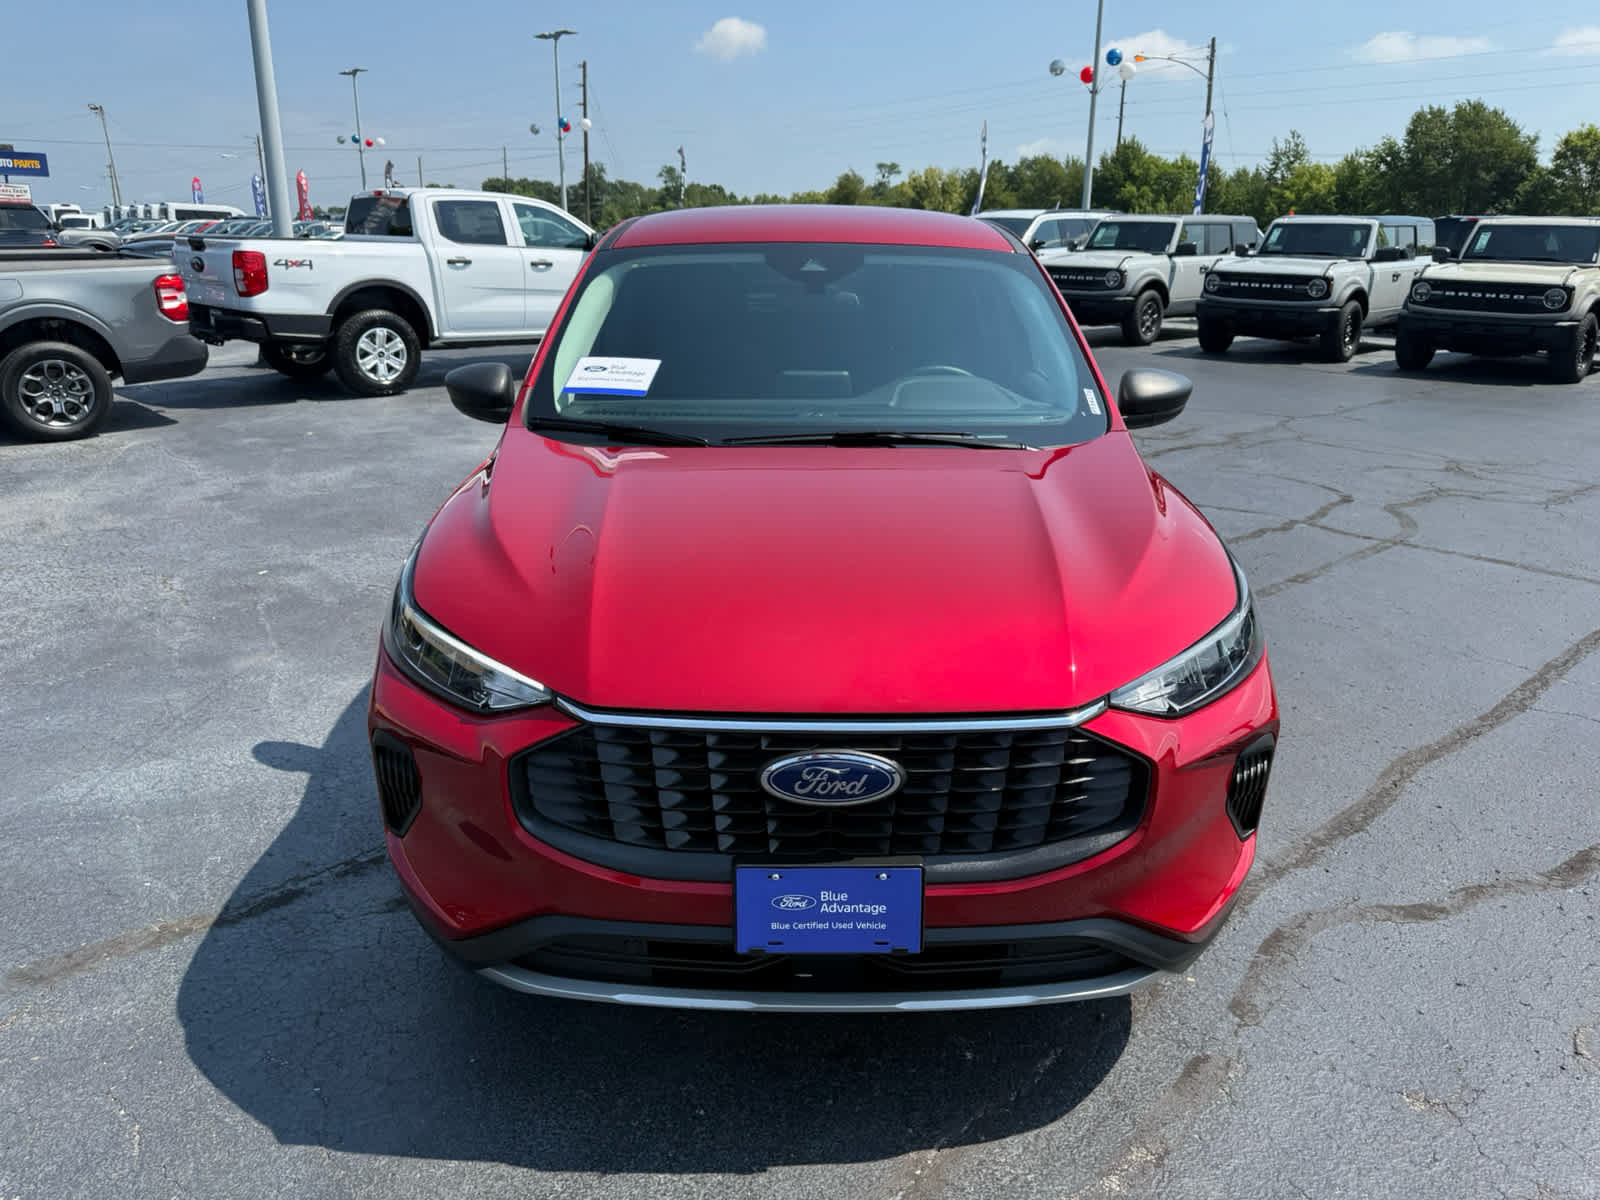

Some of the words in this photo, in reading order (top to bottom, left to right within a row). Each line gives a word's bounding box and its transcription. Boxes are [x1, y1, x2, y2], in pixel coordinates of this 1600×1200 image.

[14, 159, 41, 168] PARTS
[1230, 281, 1293, 289] BRONCO
[1444, 290, 1525, 300] BRONCO
[794, 766, 869, 795] Ford
[780, 895, 809, 908] Ford
[820, 890, 848, 902] Blue
[820, 902, 887, 916] Advantage
[771, 922, 791, 930] Blue
[792, 921, 829, 930] Certified
[831, 921, 853, 930] Used
[856, 921, 887, 930] Vehicle
